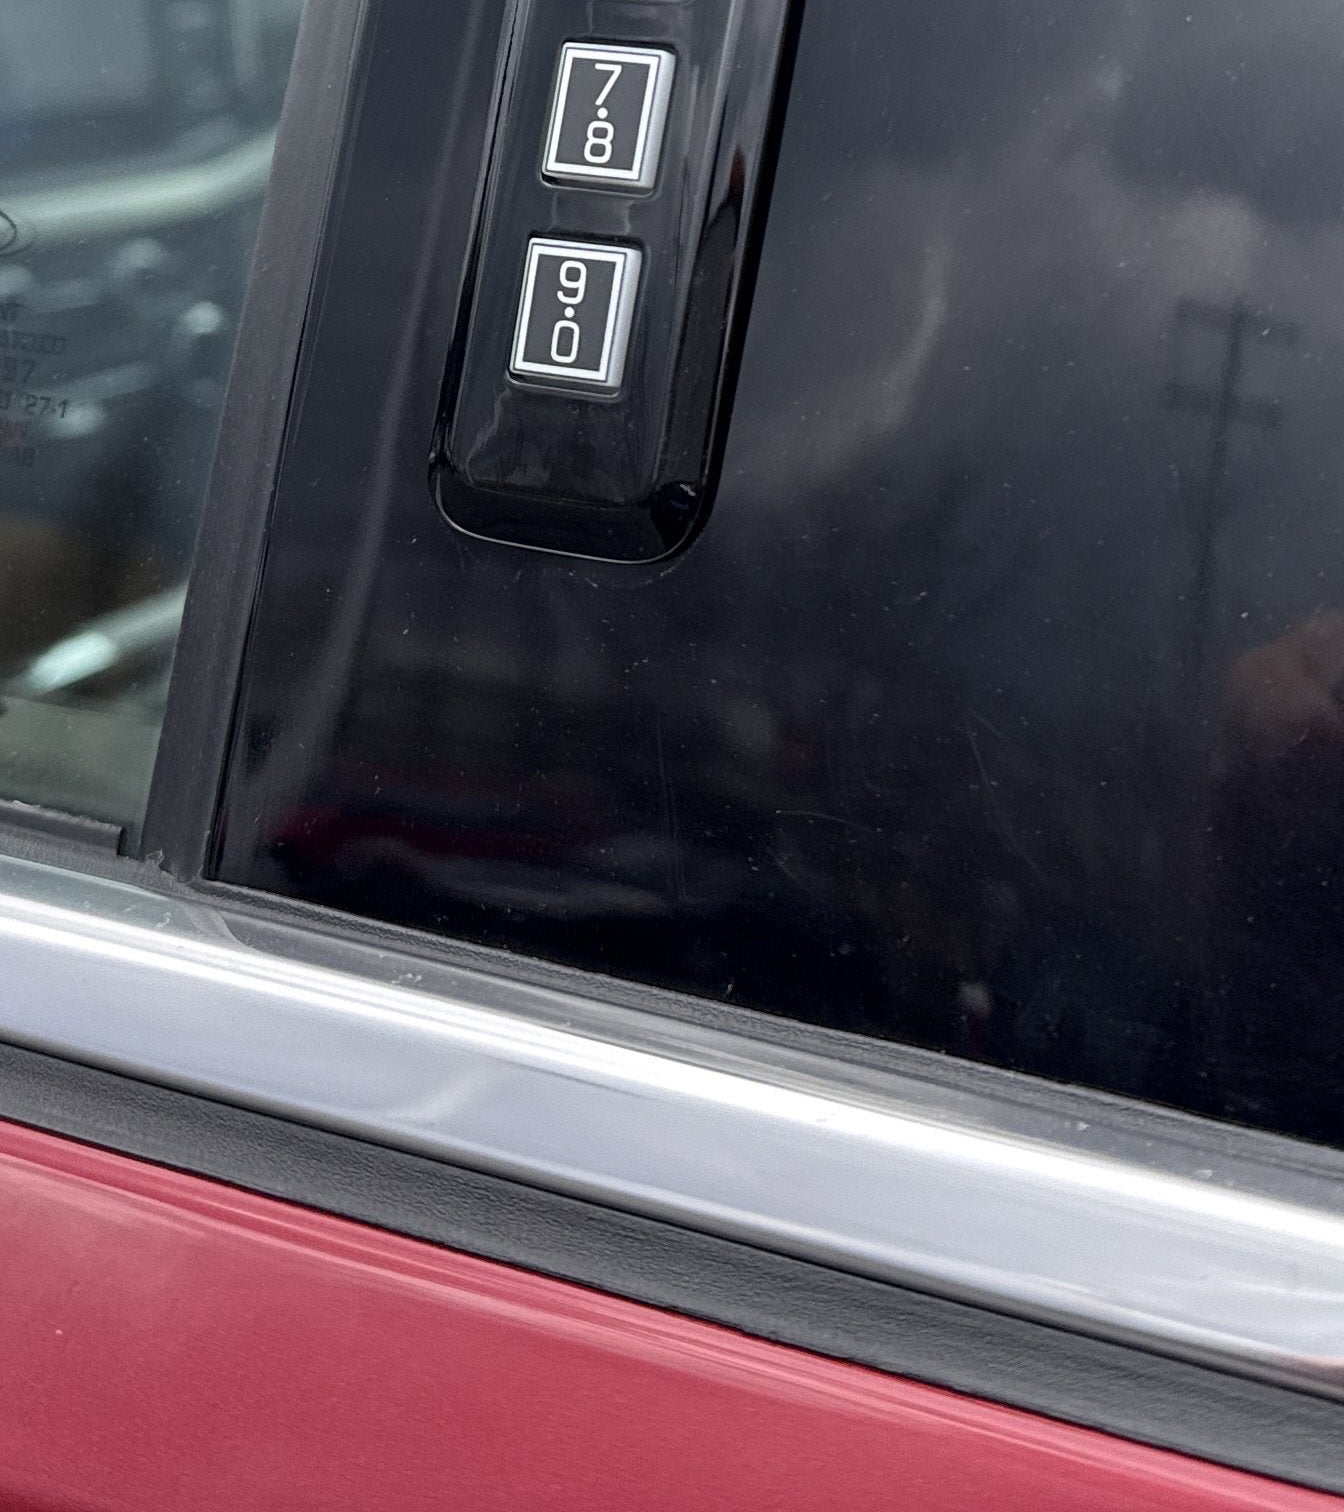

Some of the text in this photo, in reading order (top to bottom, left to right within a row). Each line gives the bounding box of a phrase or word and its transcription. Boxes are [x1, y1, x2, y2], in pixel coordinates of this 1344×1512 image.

[594, 62, 622, 106] 7
[583, 120, 614, 164] 8
[556, 260, 587, 305] 9
[550, 319, 580, 364] 0
